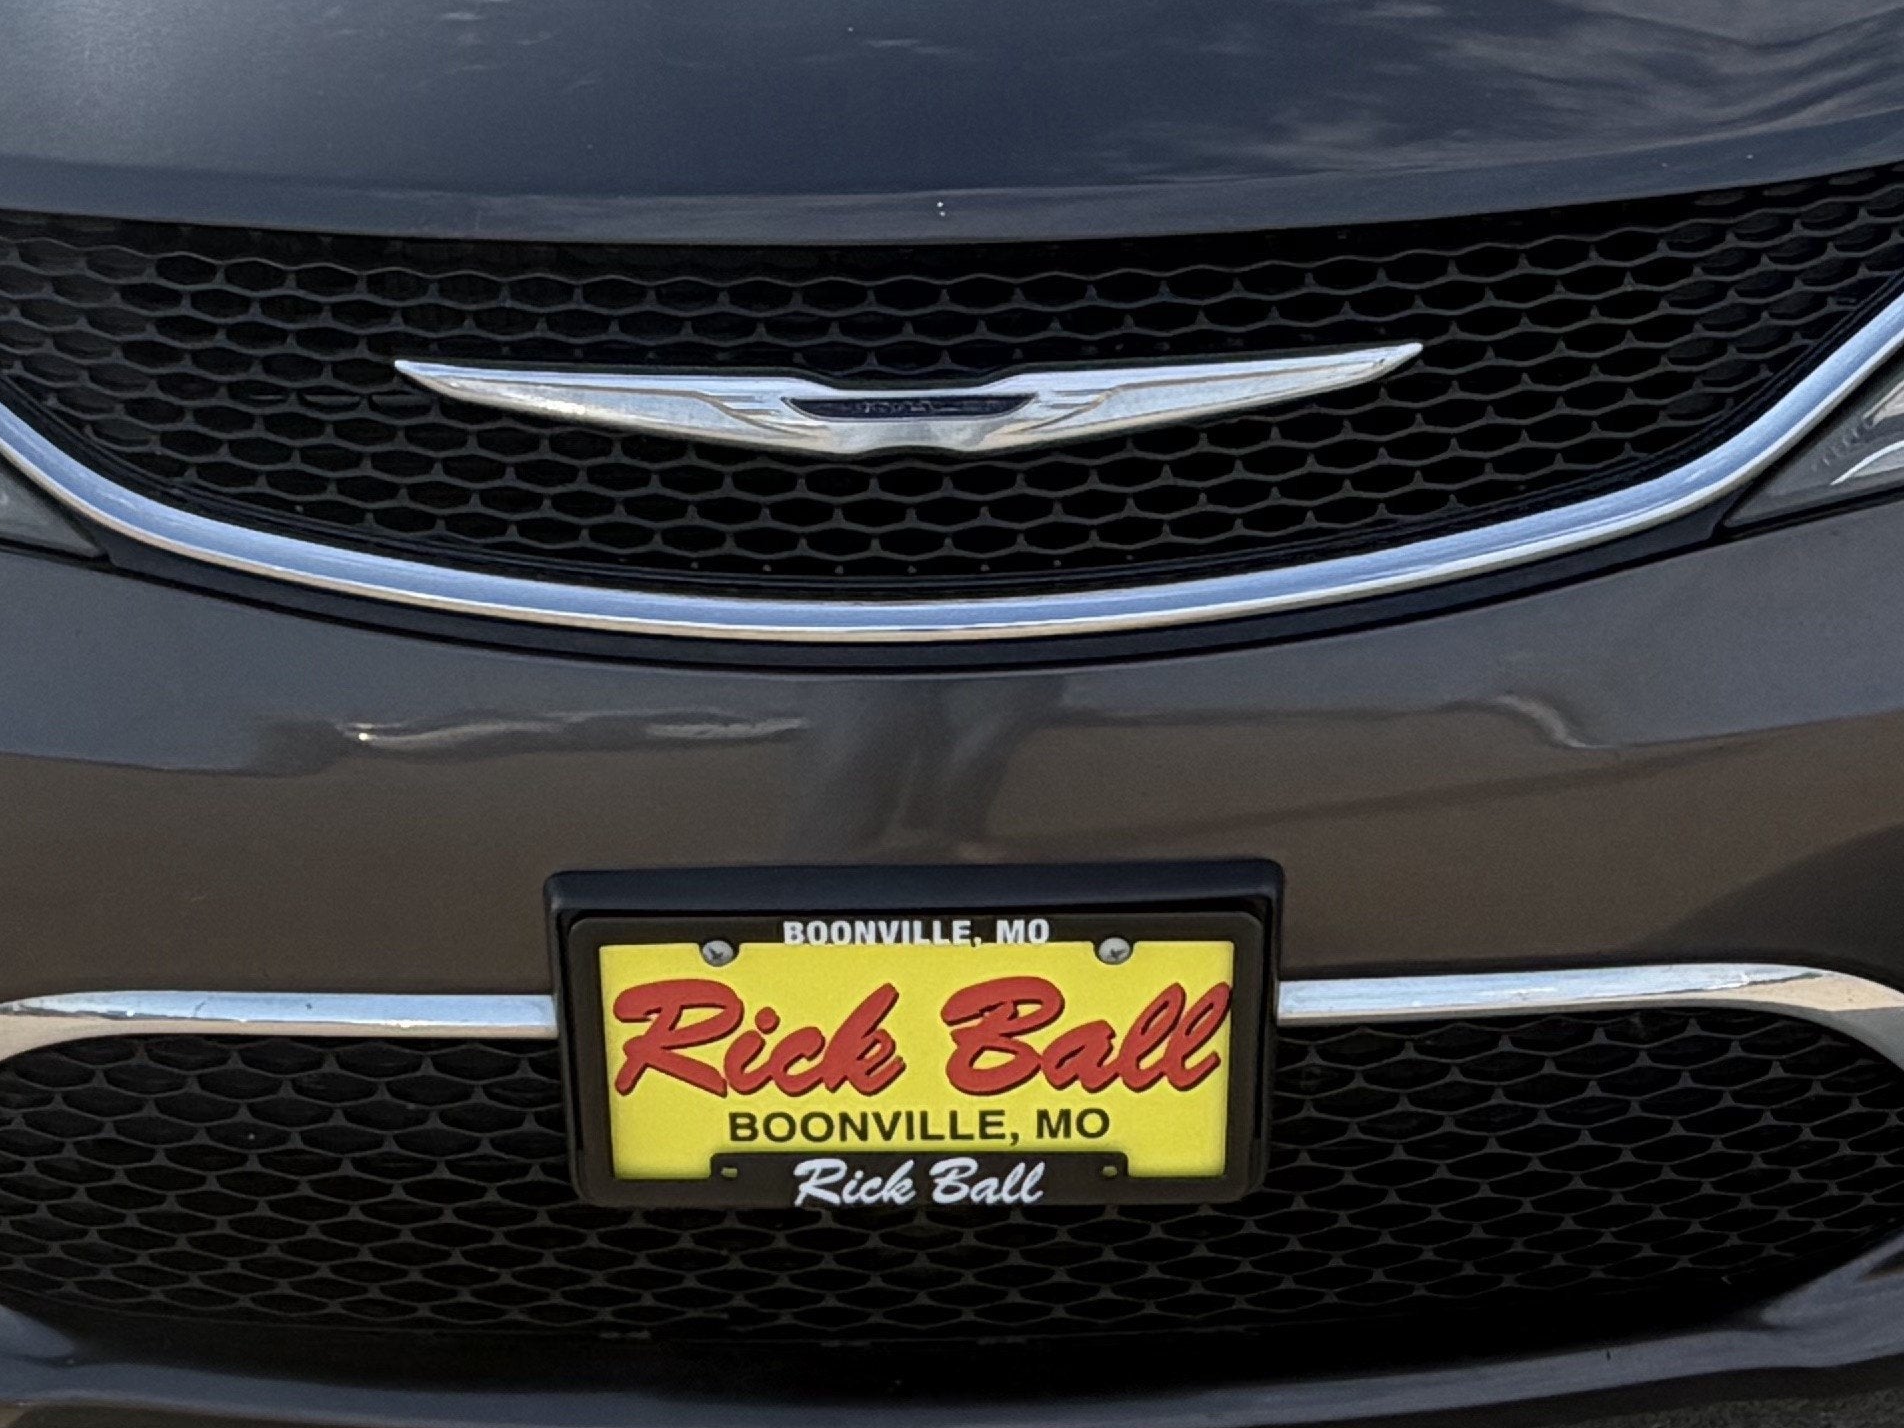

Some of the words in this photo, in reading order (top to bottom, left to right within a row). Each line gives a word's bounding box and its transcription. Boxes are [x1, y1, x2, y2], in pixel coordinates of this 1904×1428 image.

[782, 918, 983, 948] BOONVILLE,
[995, 917, 1050, 946] MO
[612, 977, 907, 1098] Rick
[940, 975, 1233, 1097] Ball
[727, 1108, 1021, 1147] BOONVILLE,
[1035, 1107, 1111, 1140] MO
[793, 1158, 917, 1208] Rick
[930, 1157, 1047, 1205] Ball
